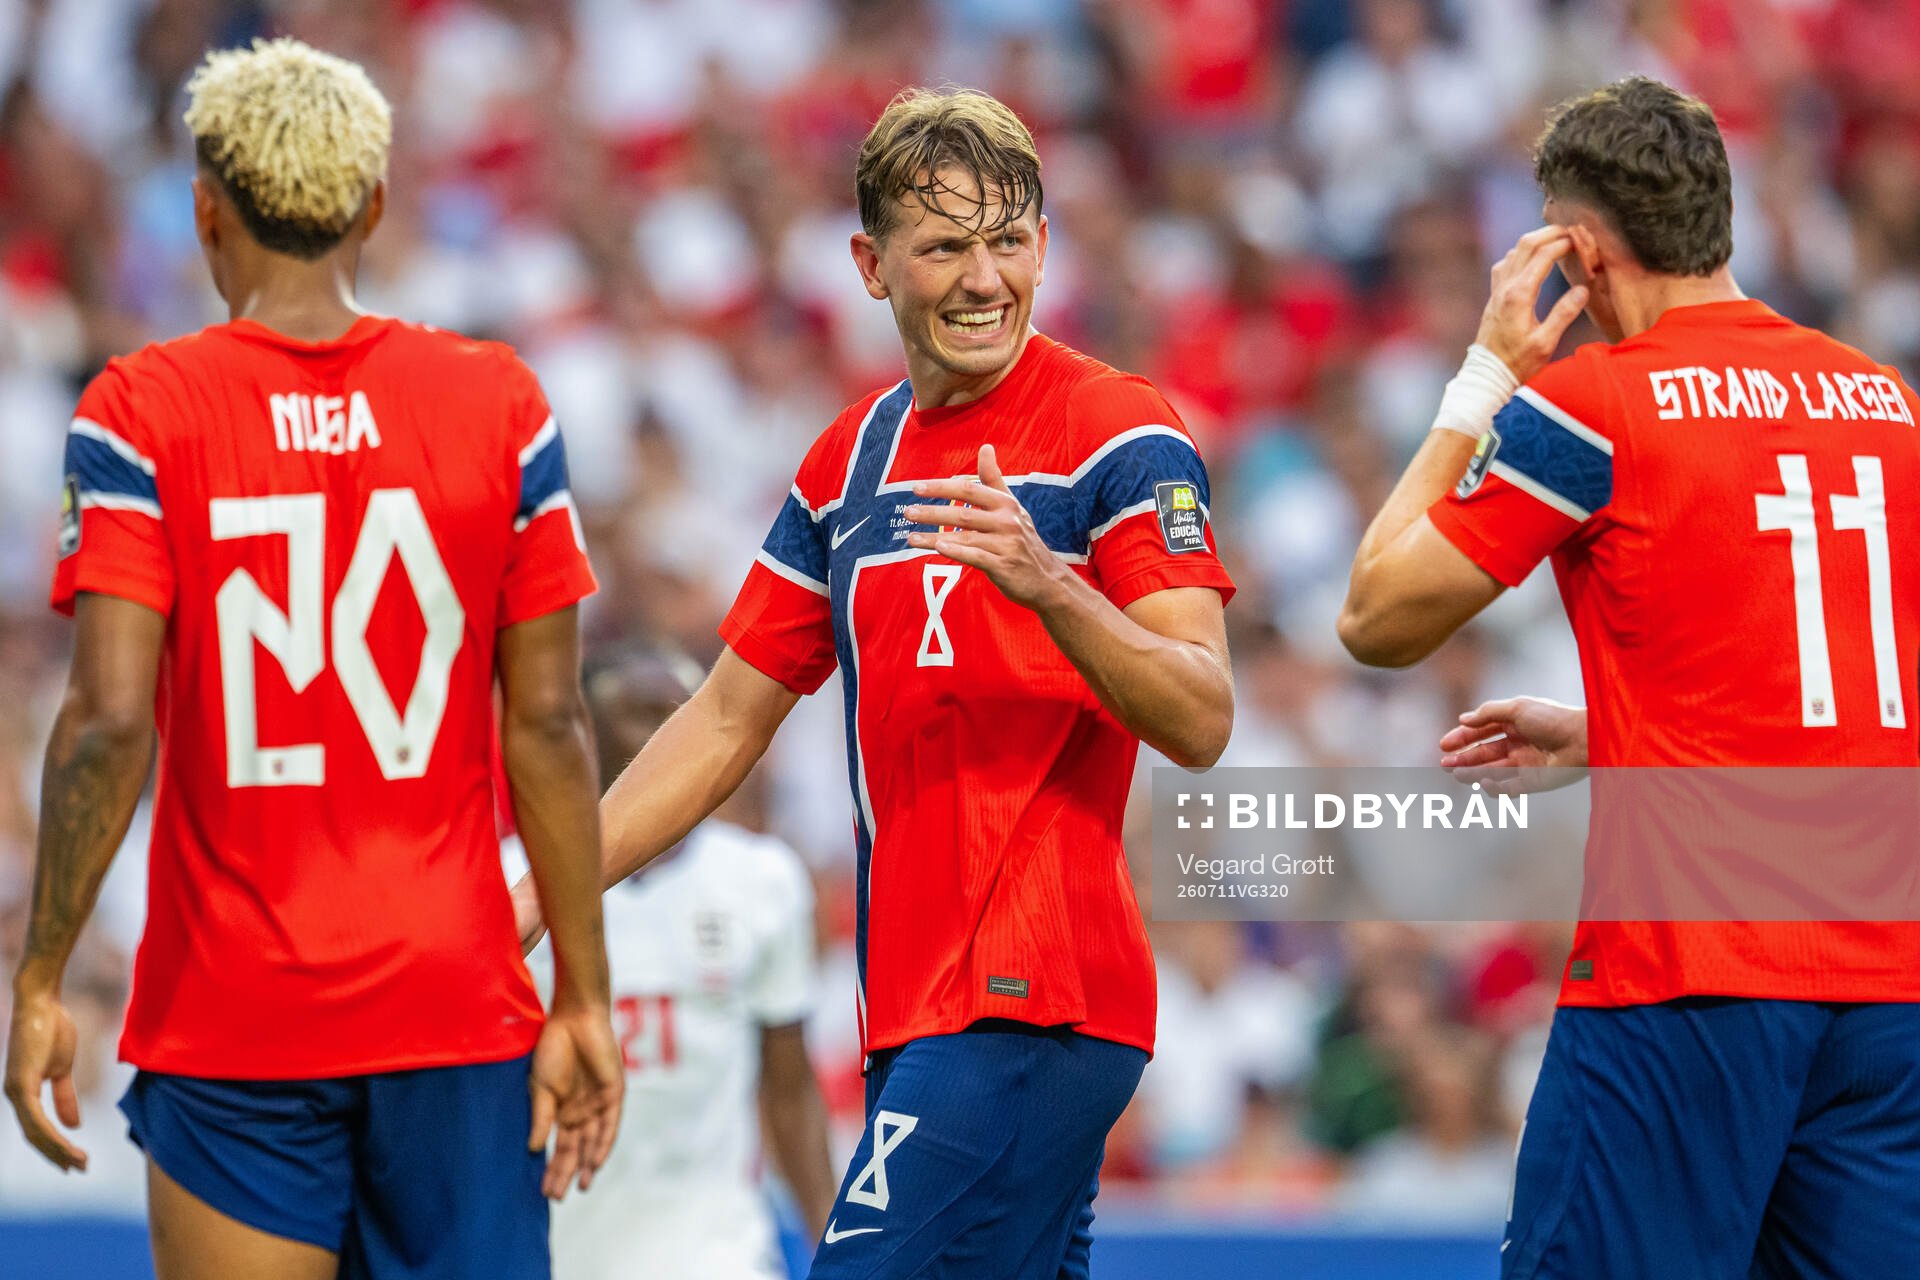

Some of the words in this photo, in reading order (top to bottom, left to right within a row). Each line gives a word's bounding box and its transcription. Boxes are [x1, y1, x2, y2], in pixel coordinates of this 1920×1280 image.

[270, 390, 382, 456] NUSA
[1649, 367, 1790, 421] STRAND
[1791, 371, 1915, 428] LARSEN
[1184, 538, 1202, 546] FIFA
[917, 563, 963, 668] 8
[1754, 454, 1906, 730] 11
[209, 487, 464, 788] 20
[615, 995, 676, 1069] 21
[846, 1109, 918, 1212] 8
